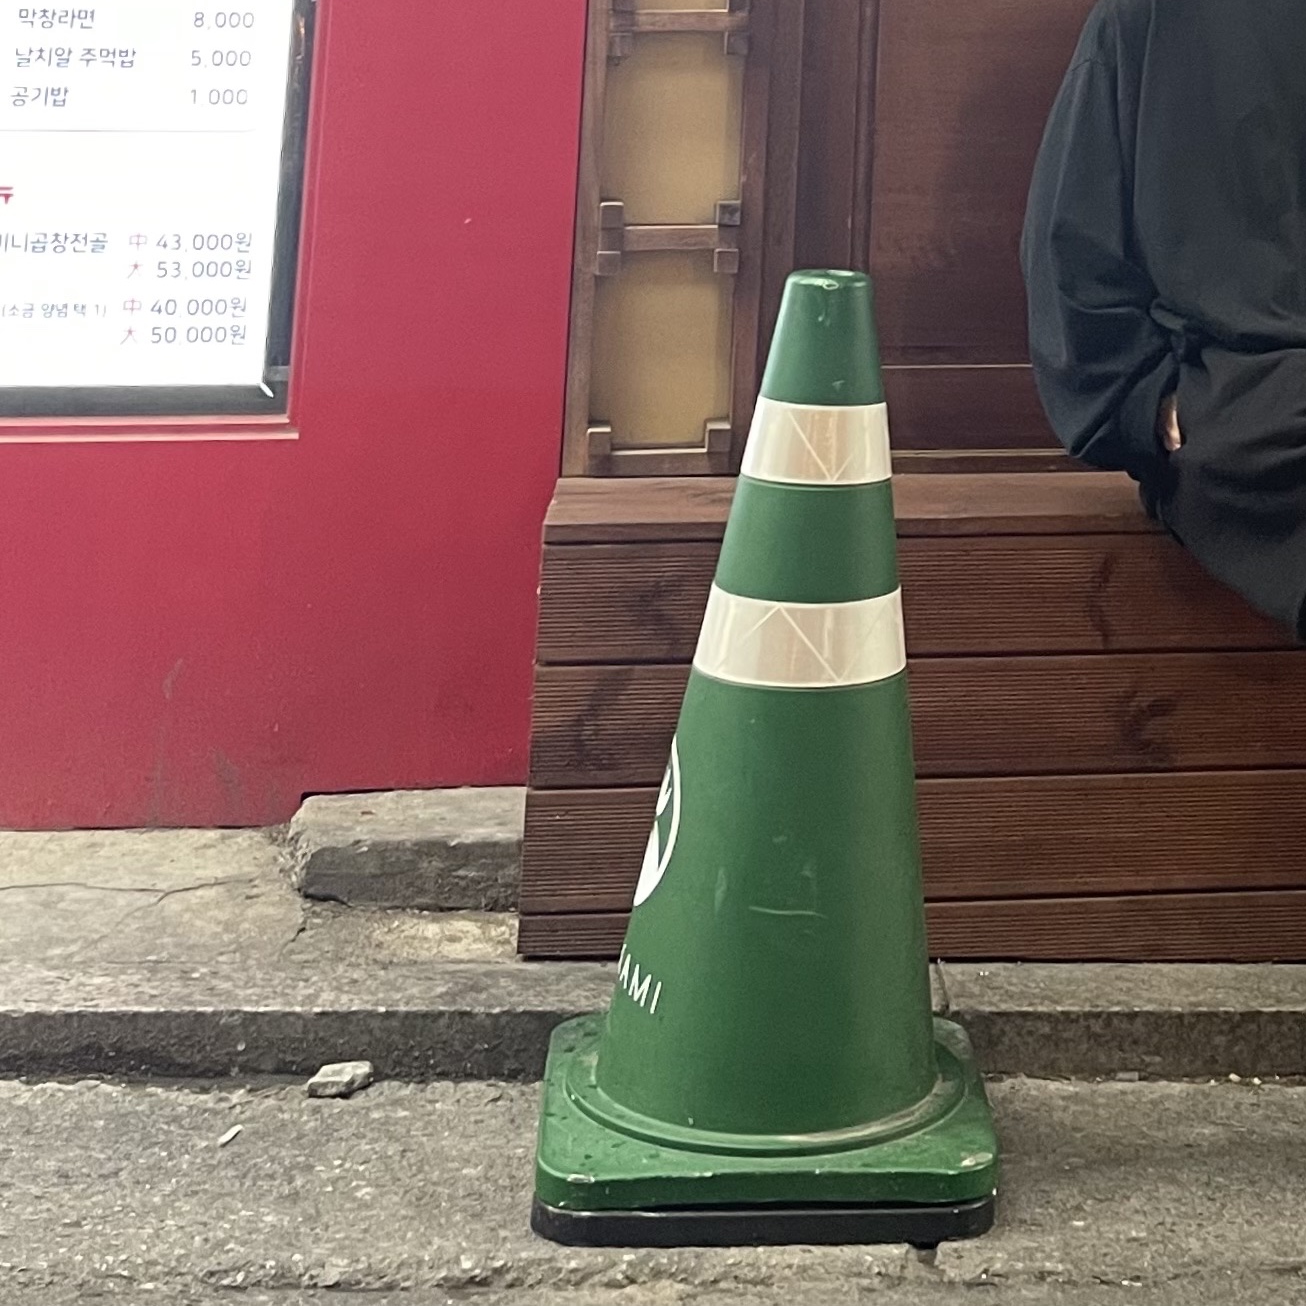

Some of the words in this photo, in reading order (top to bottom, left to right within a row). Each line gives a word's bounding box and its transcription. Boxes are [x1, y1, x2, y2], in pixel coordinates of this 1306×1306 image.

[18, 8, 96, 29] 막창라면
[15, 47, 73, 68] 날치알
[79, 48, 137, 68] 주먹밥
[11, 86, 70, 107] 공기밥
[190, 88, 249, 106] 1000
[41, 303, 69, 319] 양념
